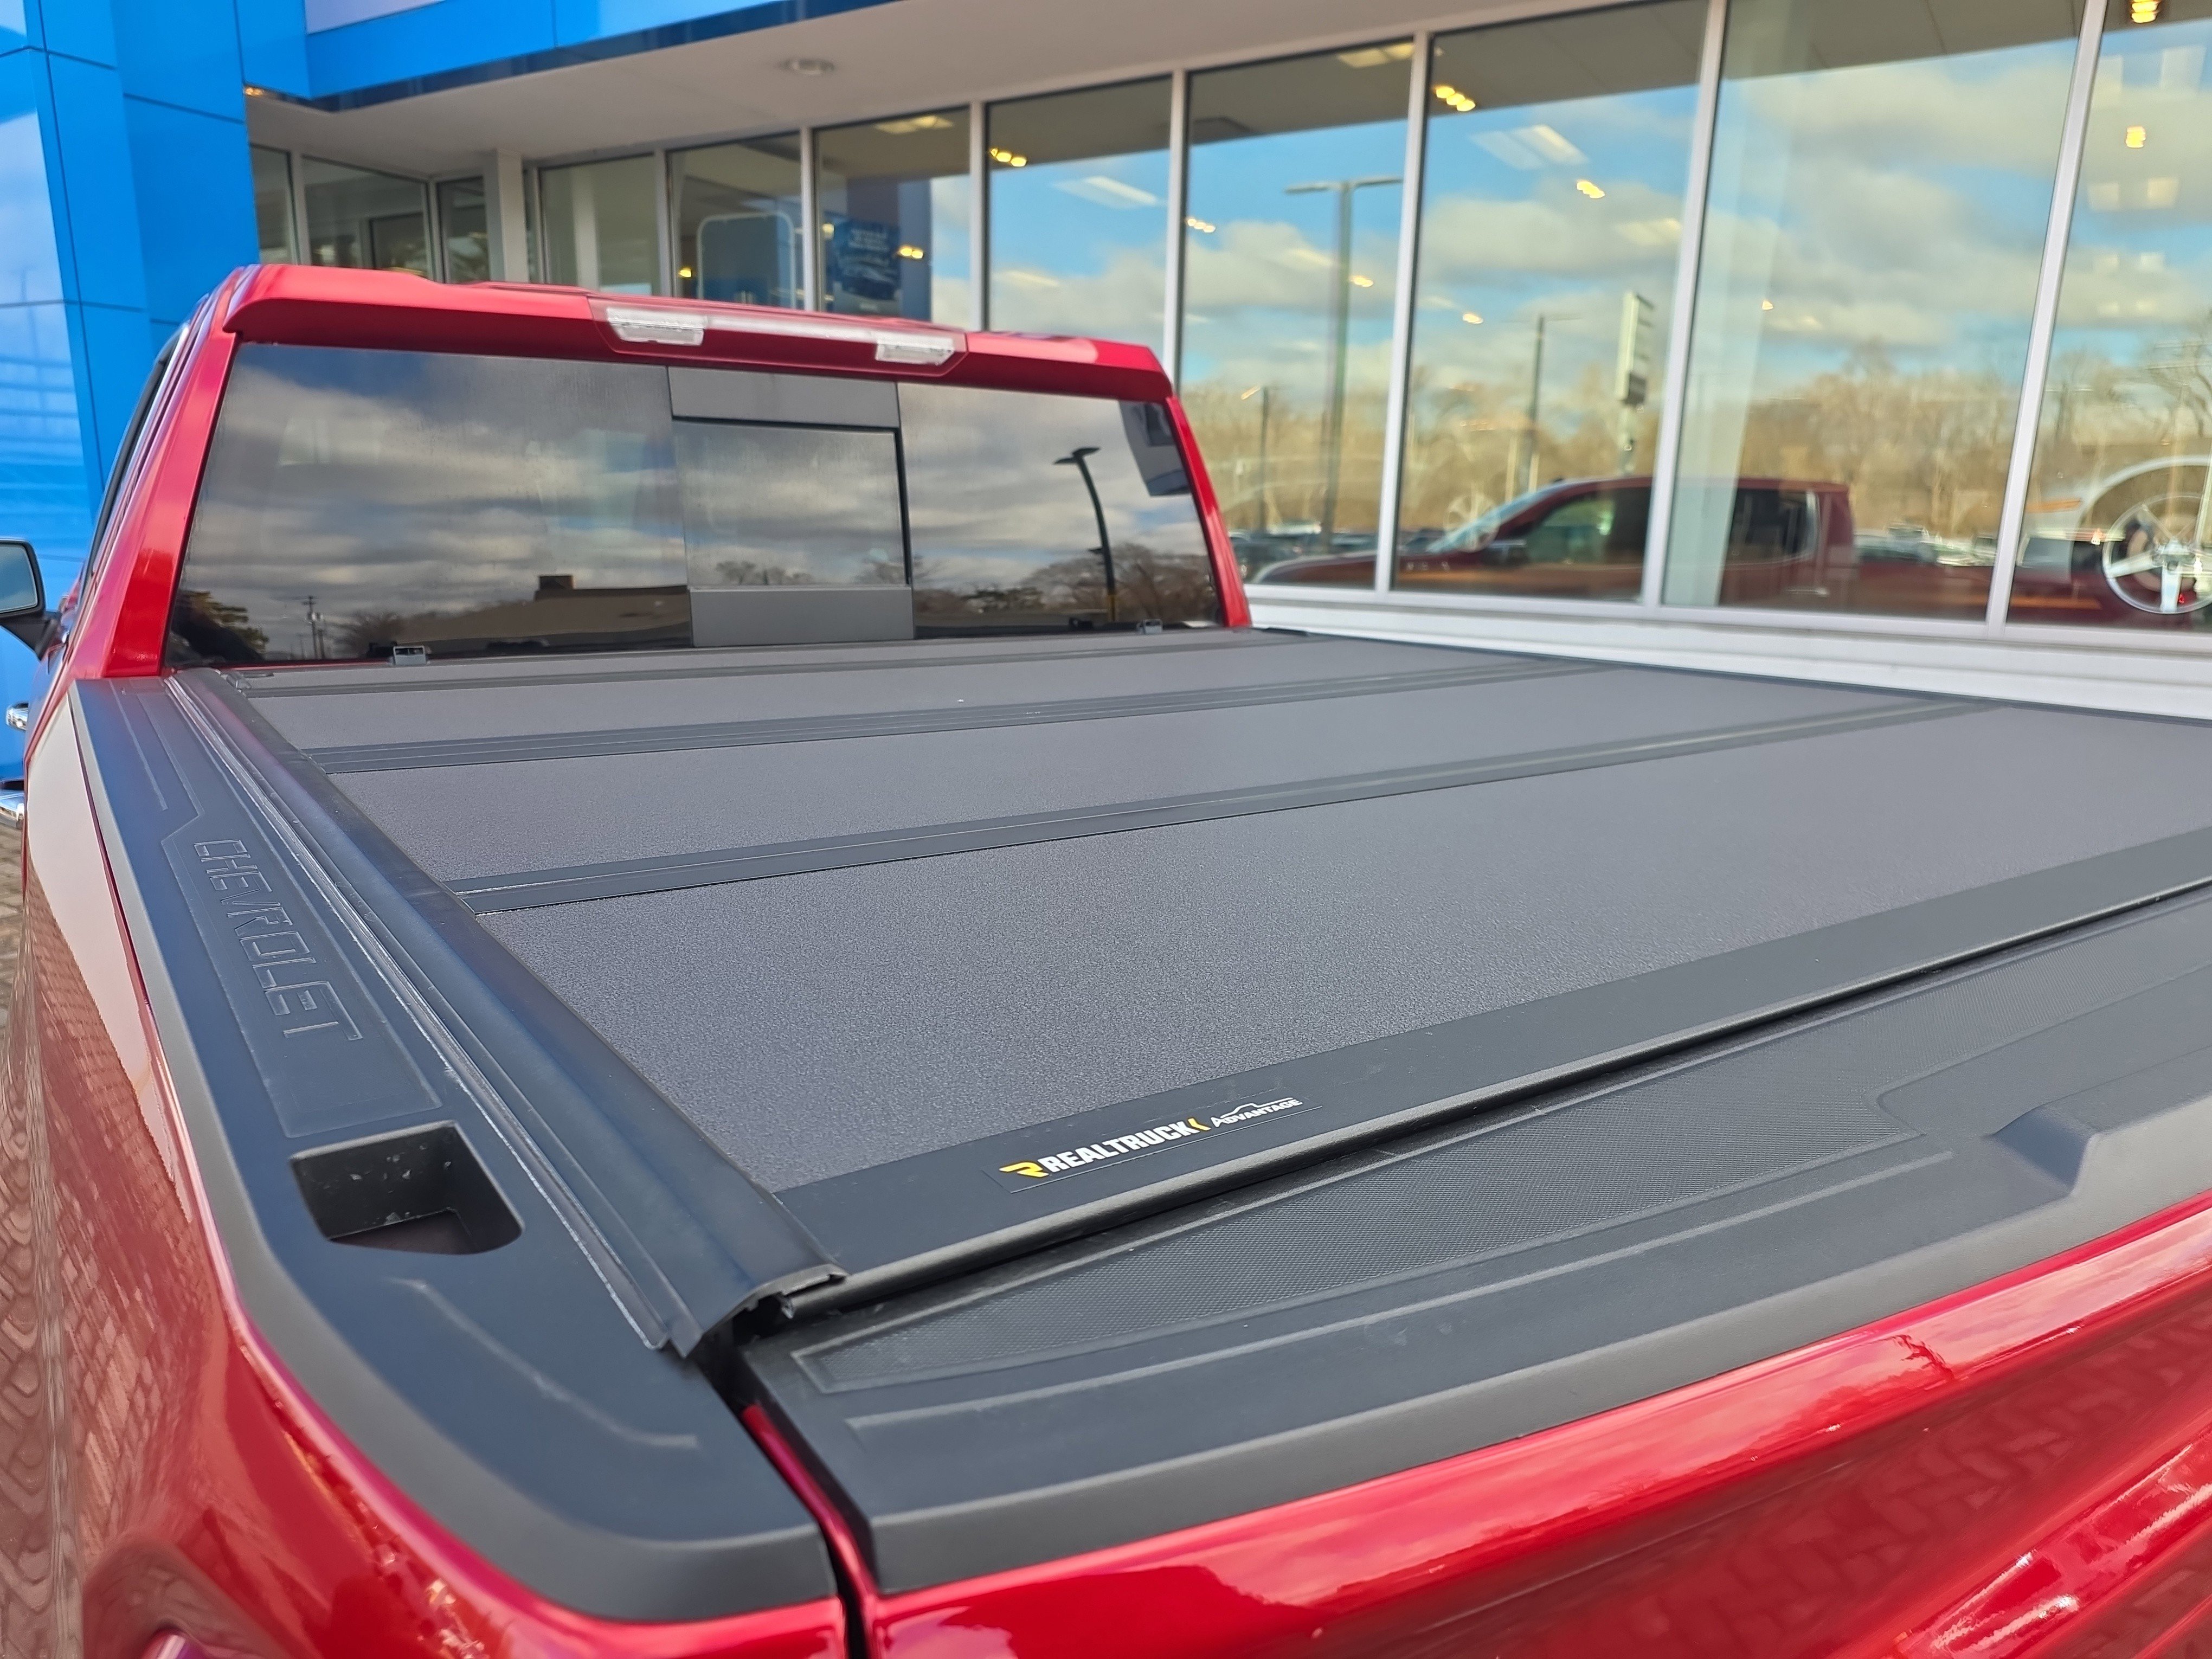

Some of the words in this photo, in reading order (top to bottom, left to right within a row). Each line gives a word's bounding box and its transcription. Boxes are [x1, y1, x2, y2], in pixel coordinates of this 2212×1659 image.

[194, 839, 363, 1041] CHEVROLET
[1037, 1121, 1200, 1173] REALTRUCK
[1210, 1098, 1303, 1128] ADVANTAGE
